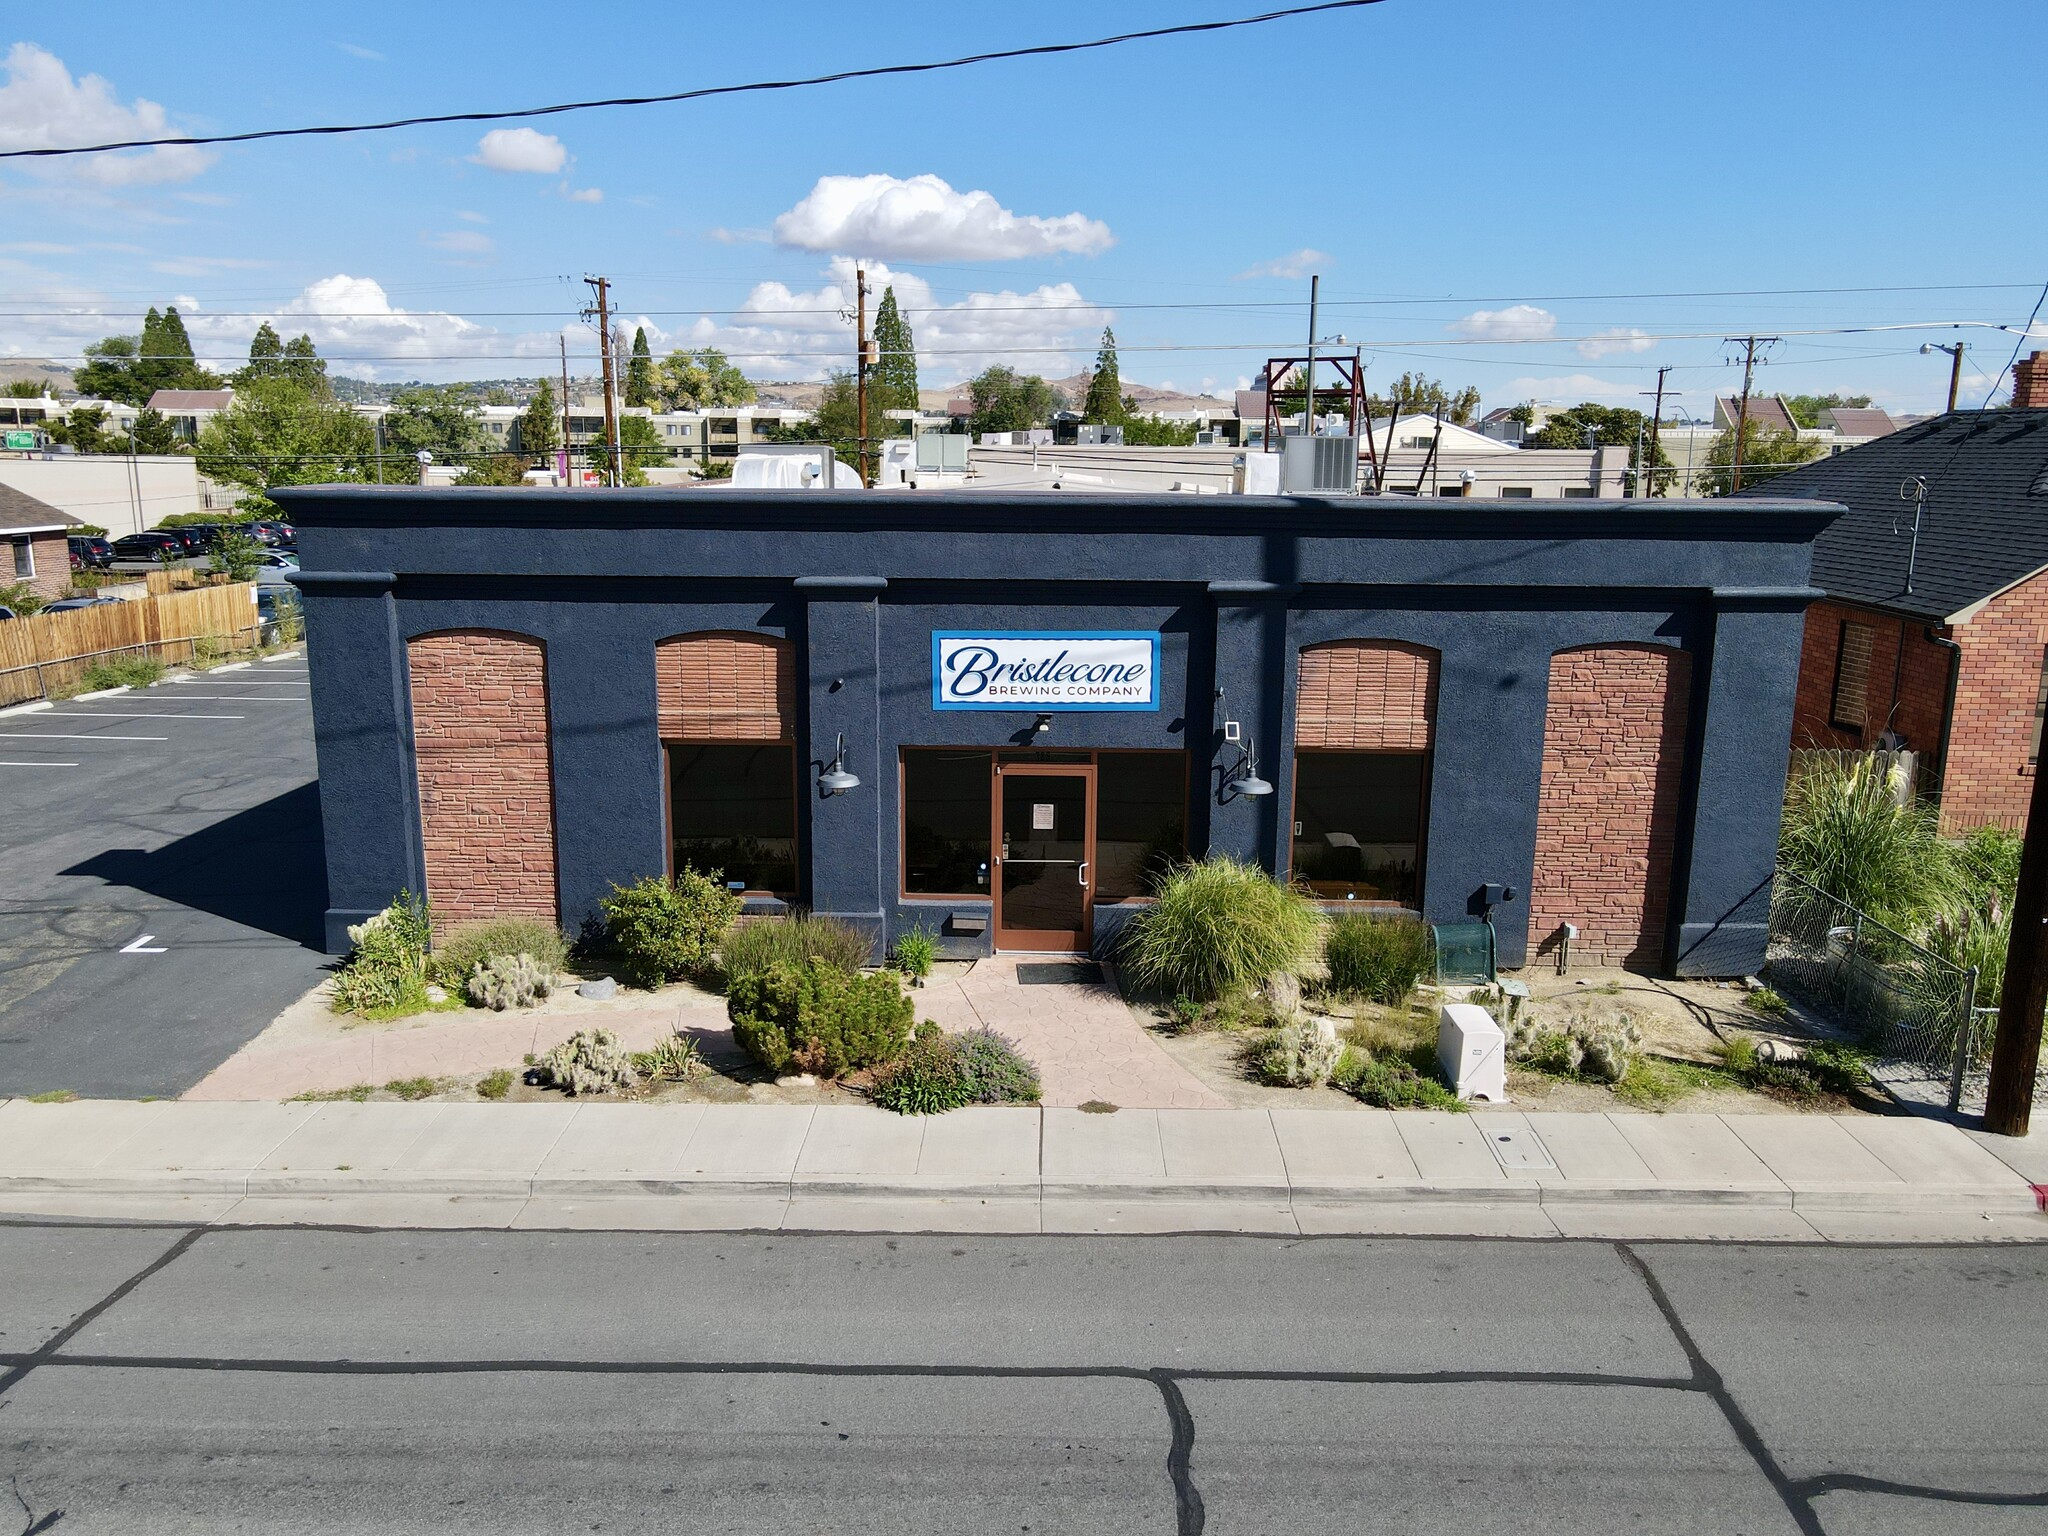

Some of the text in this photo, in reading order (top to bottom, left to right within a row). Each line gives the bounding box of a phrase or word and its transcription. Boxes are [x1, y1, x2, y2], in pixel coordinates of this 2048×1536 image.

[945, 646, 1147, 697] Bristlecone
[989, 686, 1142, 695] BREWING COMPANY
